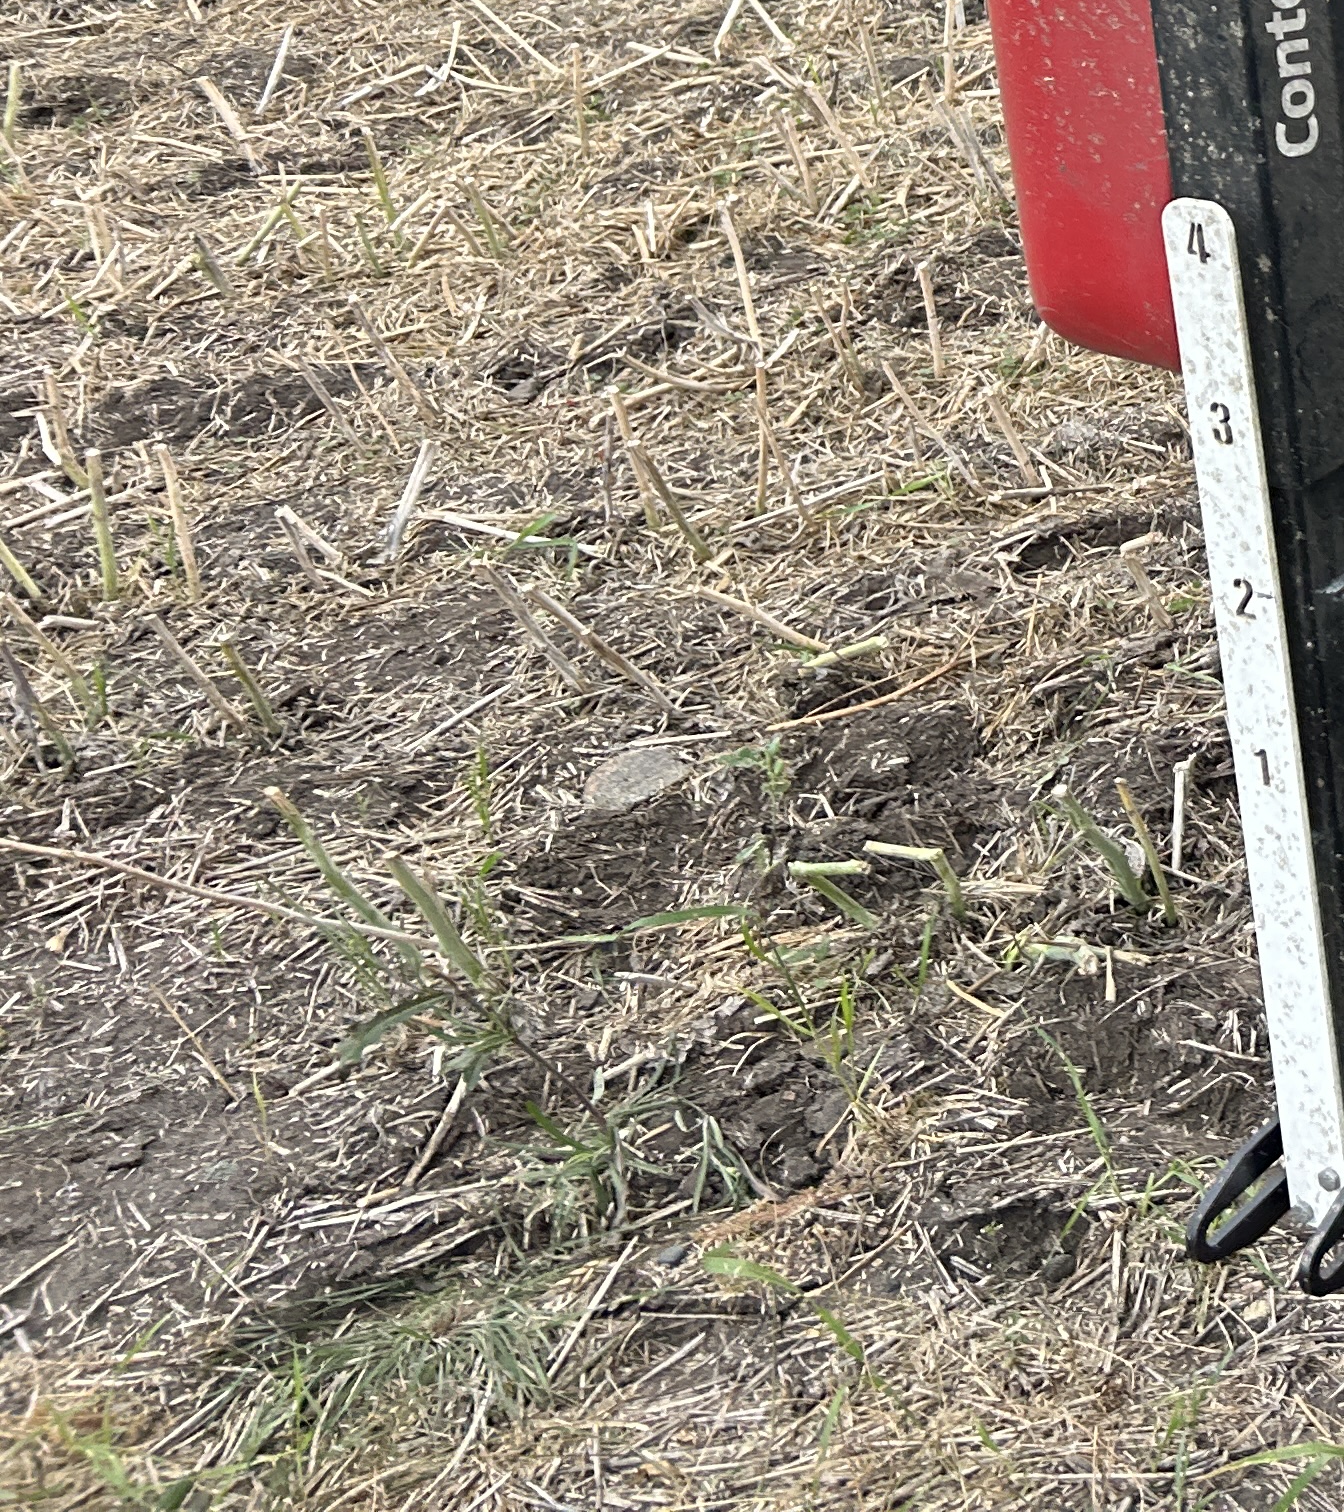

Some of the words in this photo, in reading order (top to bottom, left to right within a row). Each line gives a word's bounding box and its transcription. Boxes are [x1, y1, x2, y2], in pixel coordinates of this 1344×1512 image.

[1186, 221, 1211, 263] 4
[1209, 402, 1234, 446] 3
[1233, 578, 1257, 620] 2
[1254, 749, 1271, 786] 1
